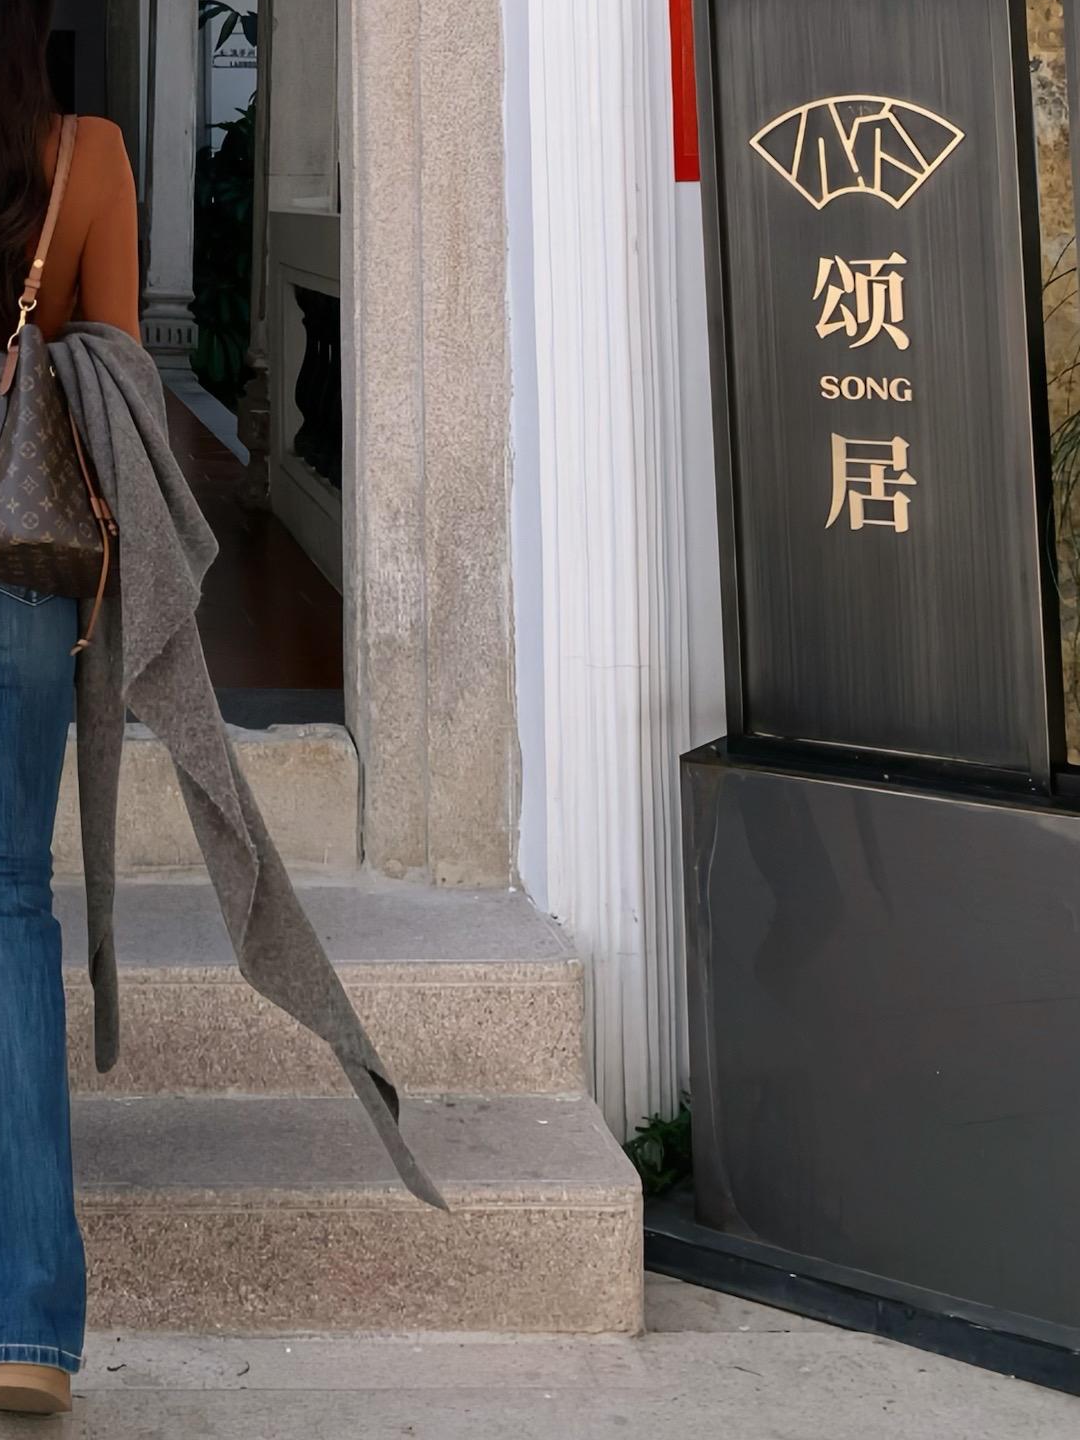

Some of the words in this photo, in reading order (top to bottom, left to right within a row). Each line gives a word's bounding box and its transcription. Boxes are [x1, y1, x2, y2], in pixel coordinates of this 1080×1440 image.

[812, 251, 910, 351] 颂
[820, 375, 913, 402] SONG
[825, 432, 918, 533] 居
